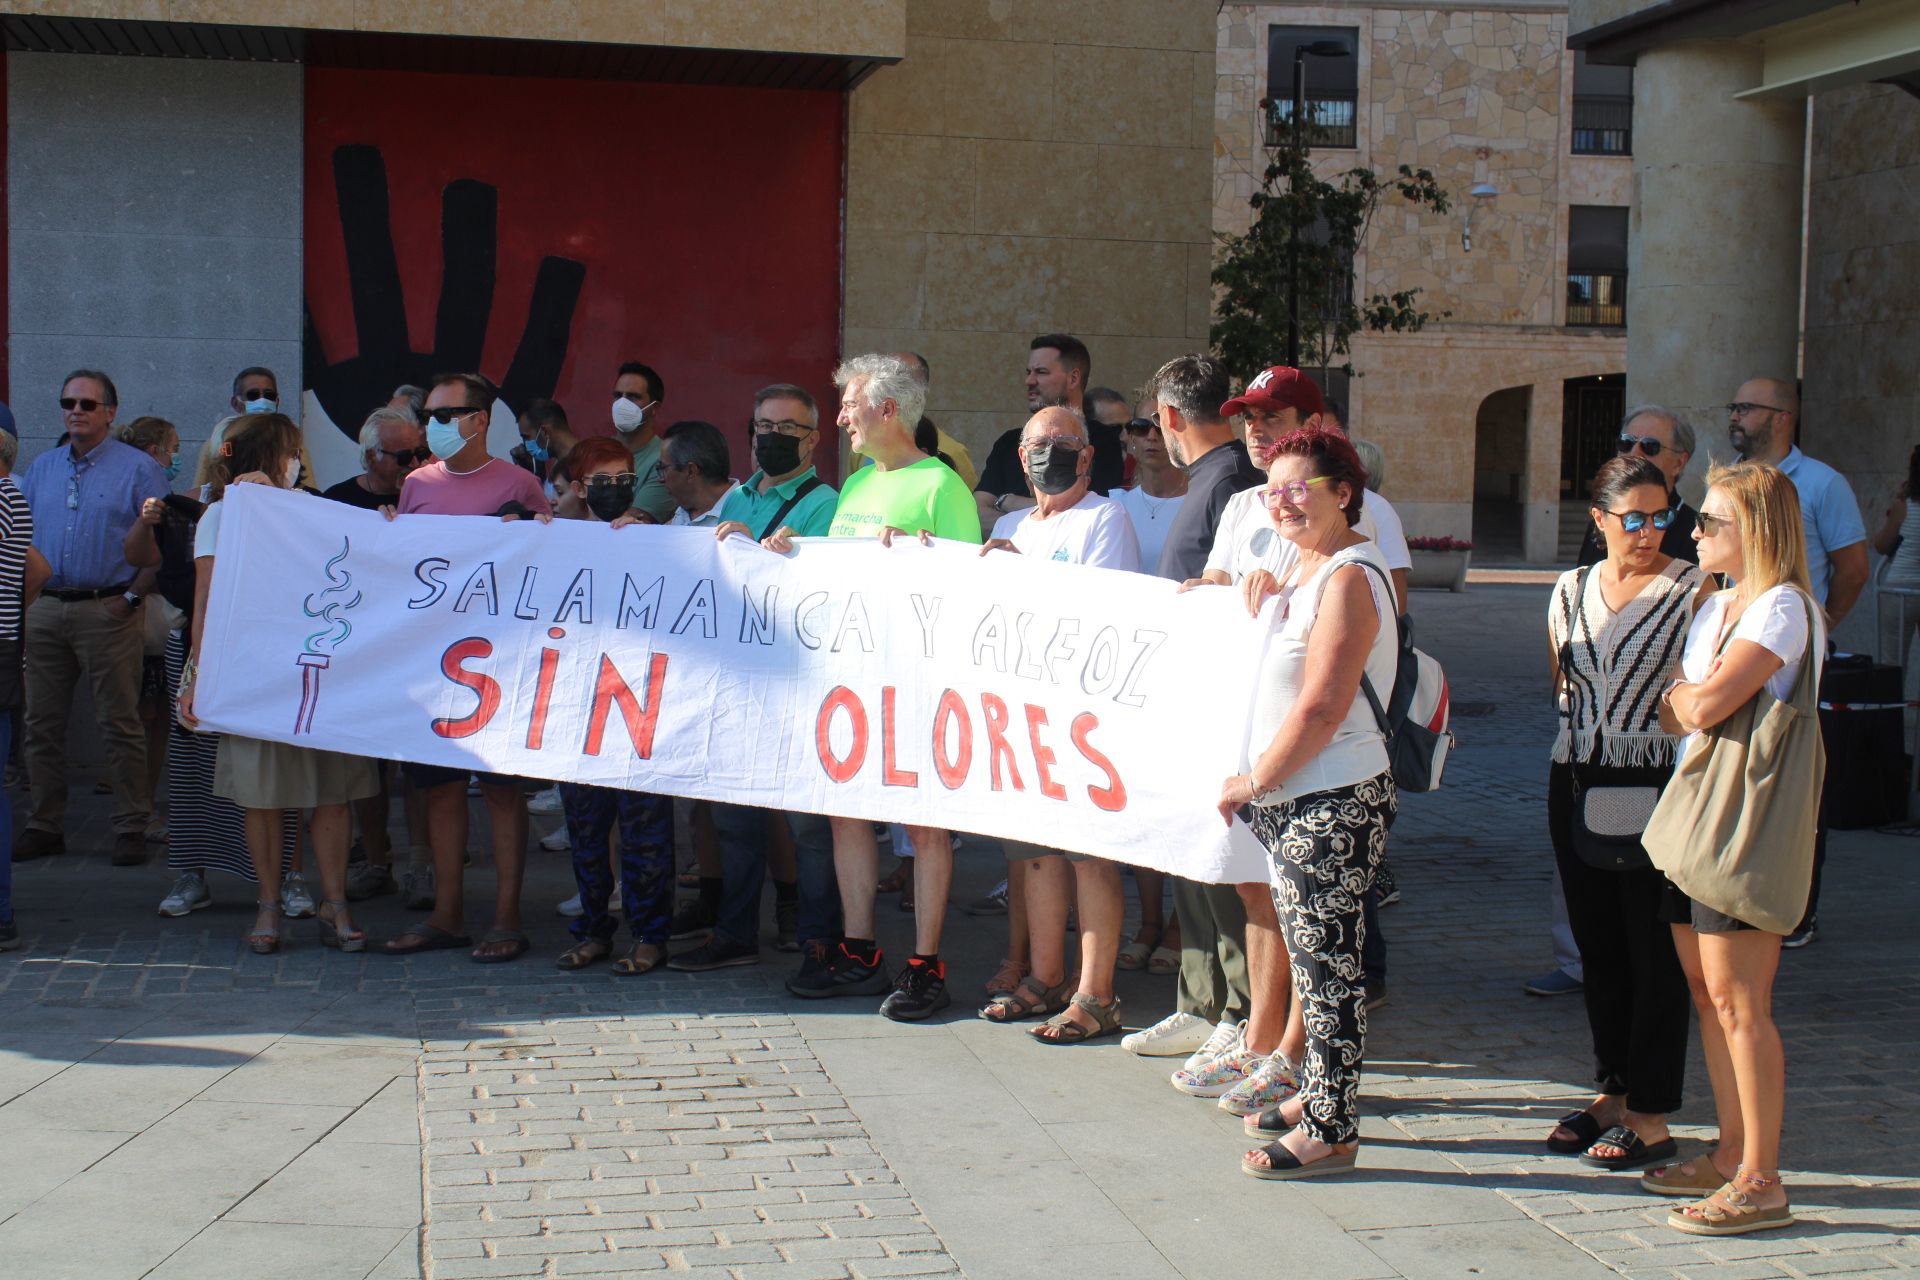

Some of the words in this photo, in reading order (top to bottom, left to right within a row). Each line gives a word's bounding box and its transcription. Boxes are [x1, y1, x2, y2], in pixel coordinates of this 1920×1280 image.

[842, 512, 883, 525] marcha
[408, 556, 875, 653] SALAMANCA
[909, 593, 943, 658] Y
[972, 603, 1168, 708] ALFOZ
[815, 685, 1128, 811] OLORES
